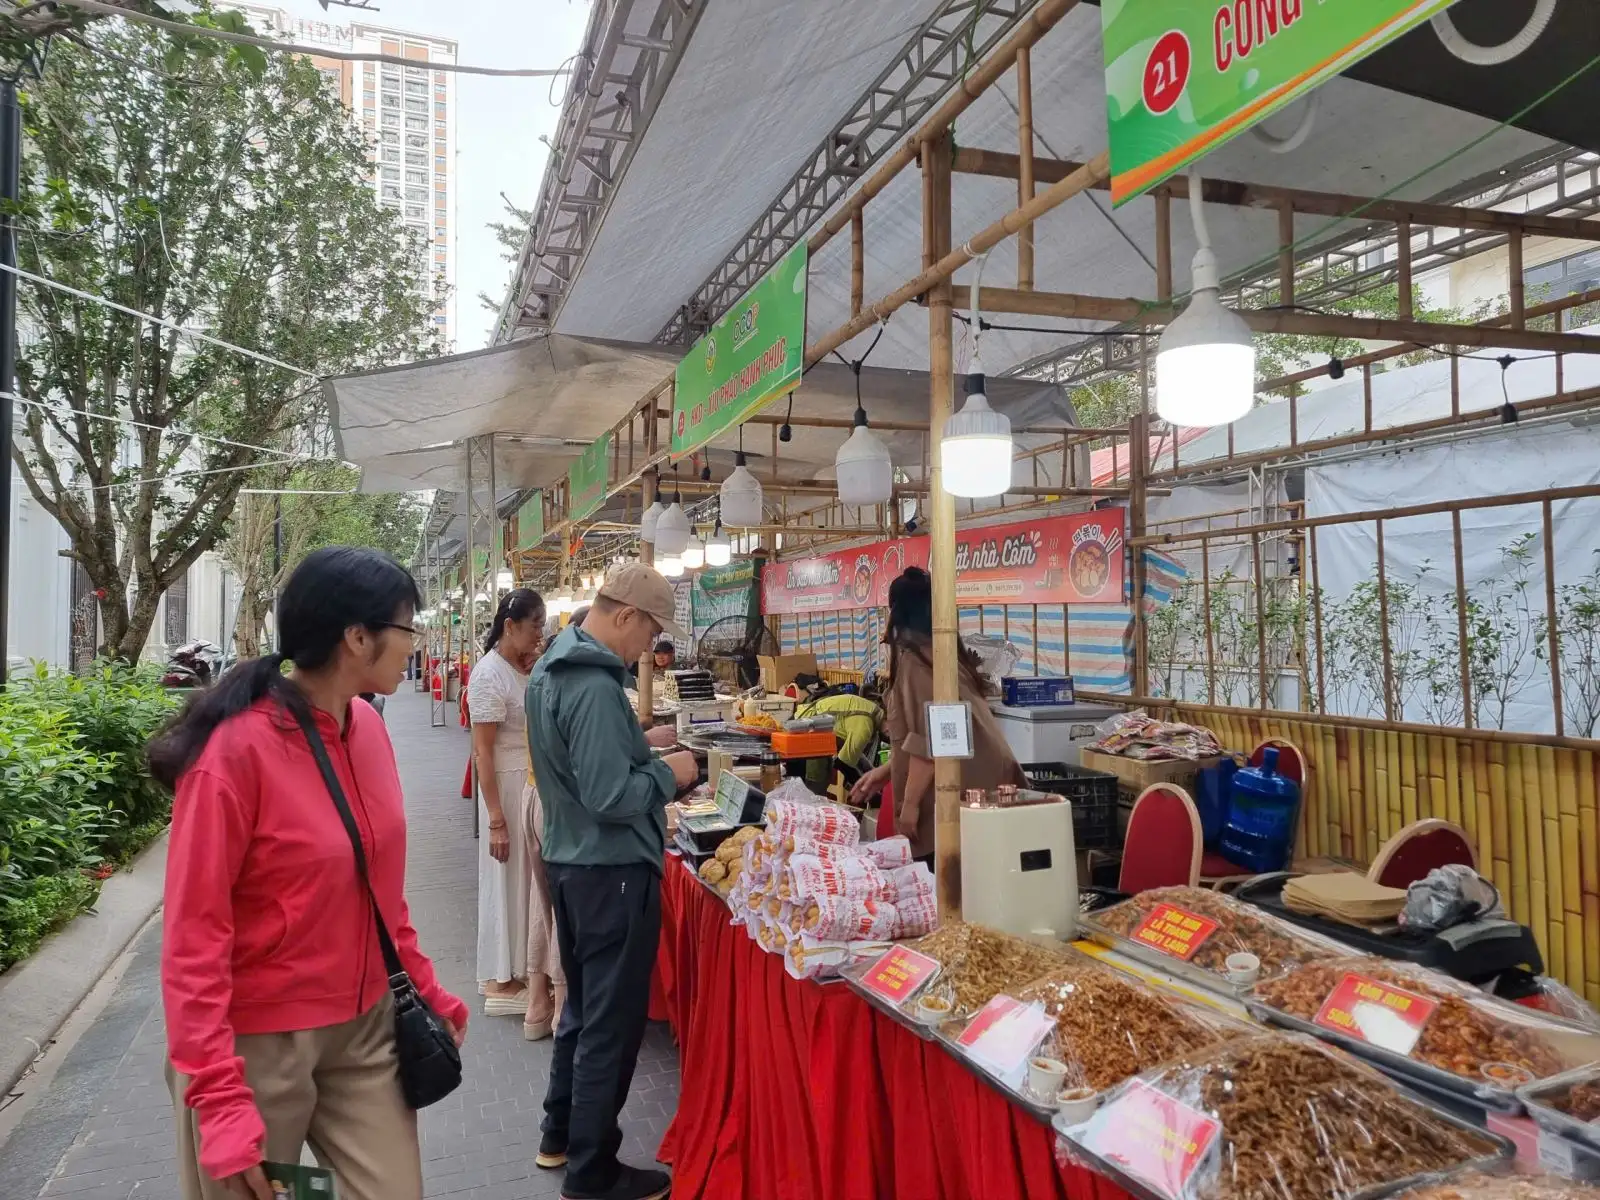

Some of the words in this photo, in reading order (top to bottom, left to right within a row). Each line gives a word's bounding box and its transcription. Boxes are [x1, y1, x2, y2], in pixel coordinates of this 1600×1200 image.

[1152, 50, 1179, 96] 21
[971, 539, 999, 569] nhà
[1002, 532, 1036, 567] Cốm
